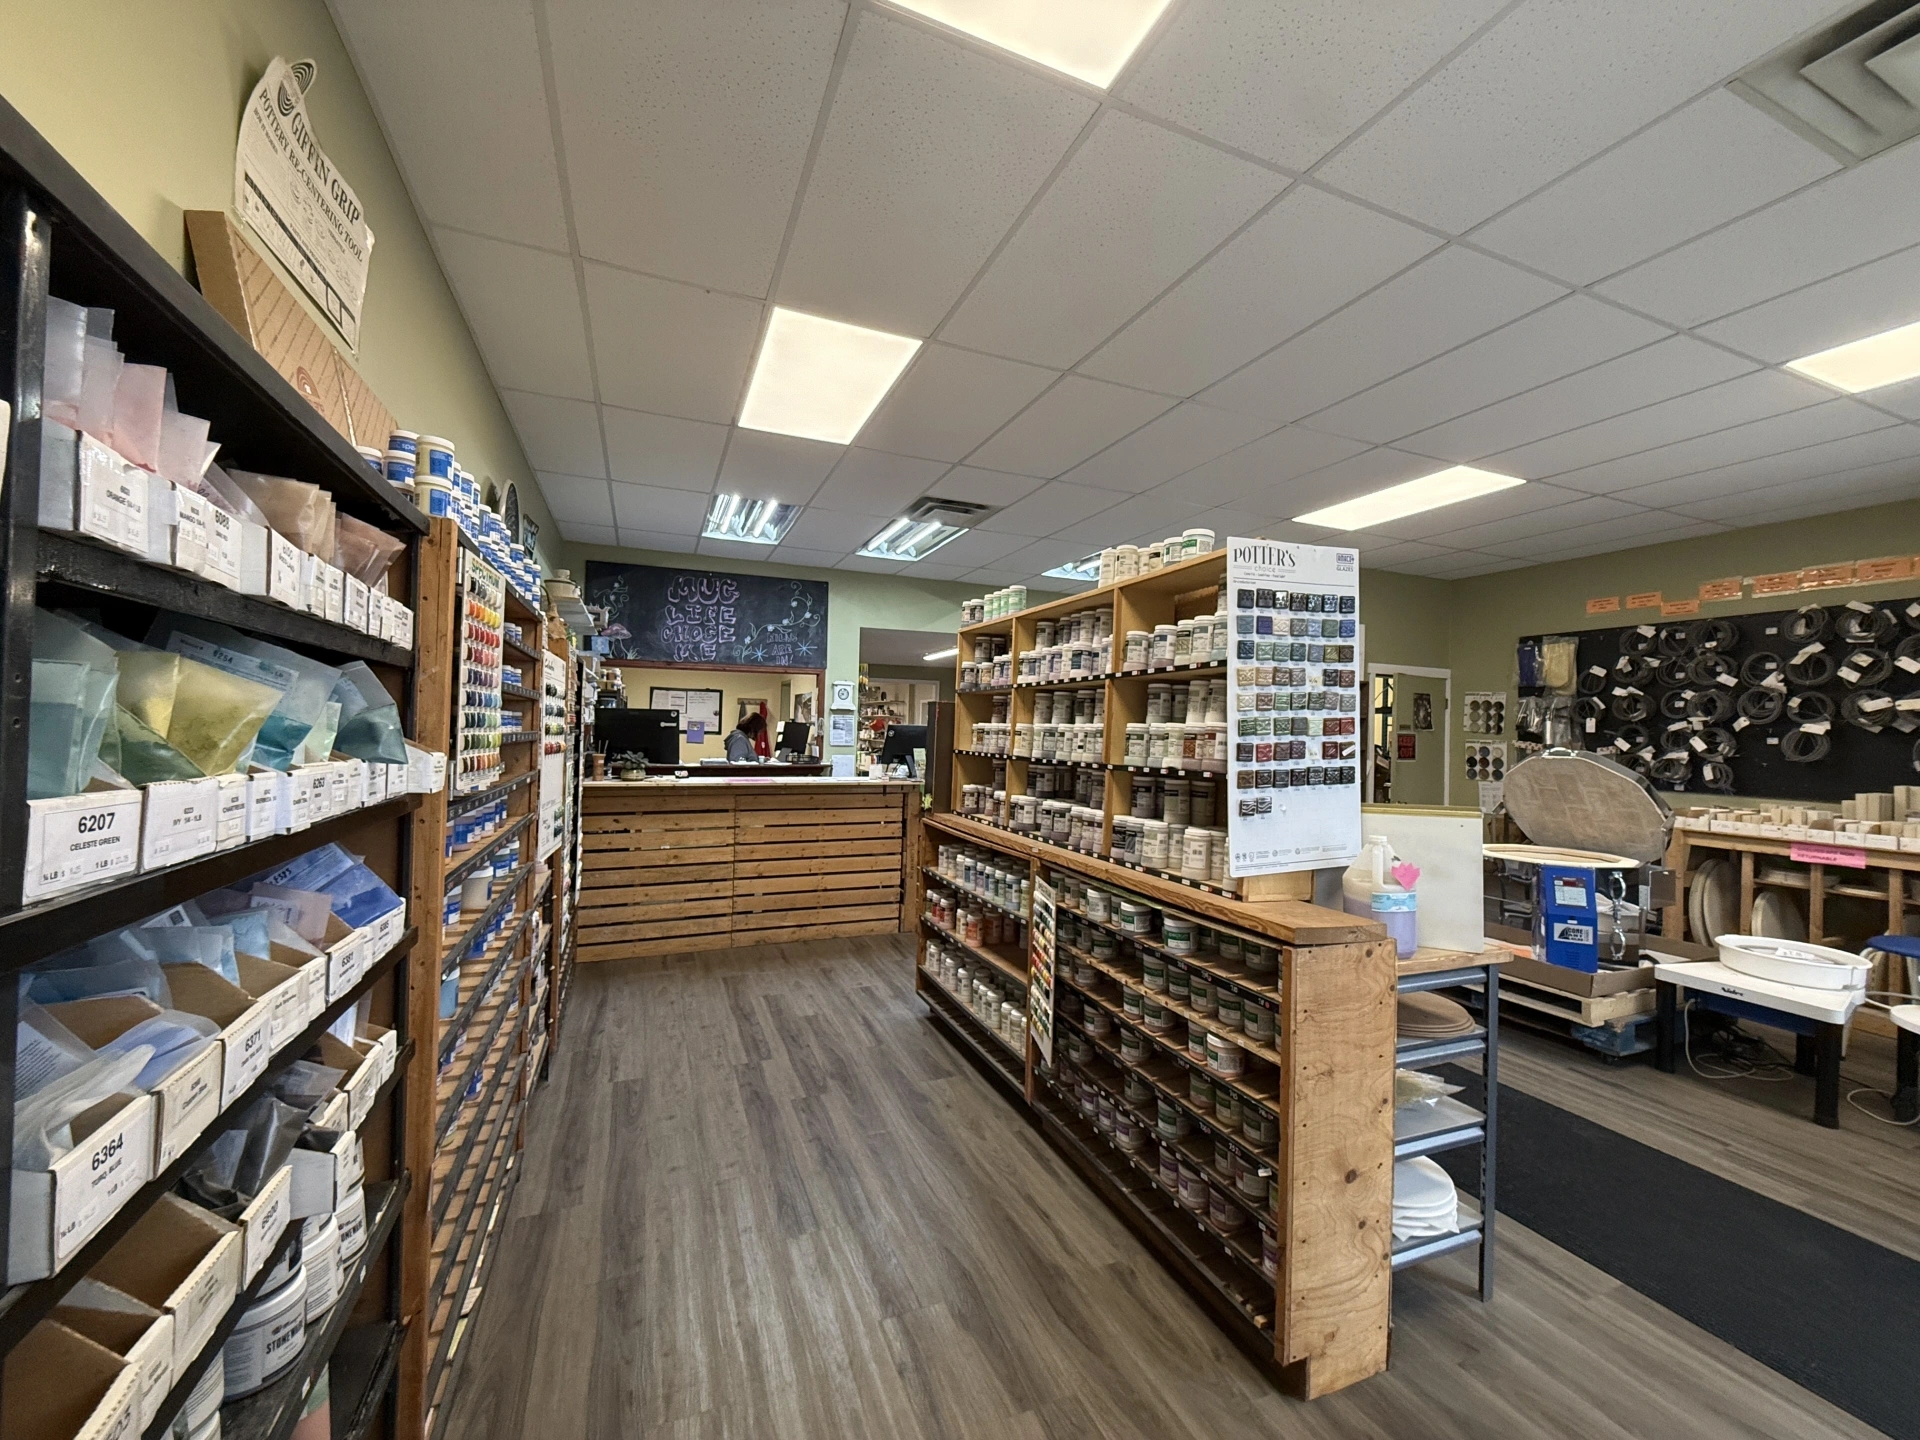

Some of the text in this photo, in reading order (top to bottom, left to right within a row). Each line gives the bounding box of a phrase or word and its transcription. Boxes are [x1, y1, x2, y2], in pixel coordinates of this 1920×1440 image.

[259, 87, 363, 262] POTTERY RE-CENTERING TOOL
[291, 112, 361, 226] GIFFIN GRIP
[1233, 544, 1296, 567] POTTER'S
[667, 575, 740, 605] MUG
[664, 604, 737, 625] LIFE
[660, 624, 737, 644] CHOSE
[672, 643, 717, 662] ME
[77, 812, 116, 834] 6207
[69, 836, 121, 852] CELESTE GREEN
[244, 1028, 262, 1053] 6371
[91, 1133, 124, 1171] 6364
